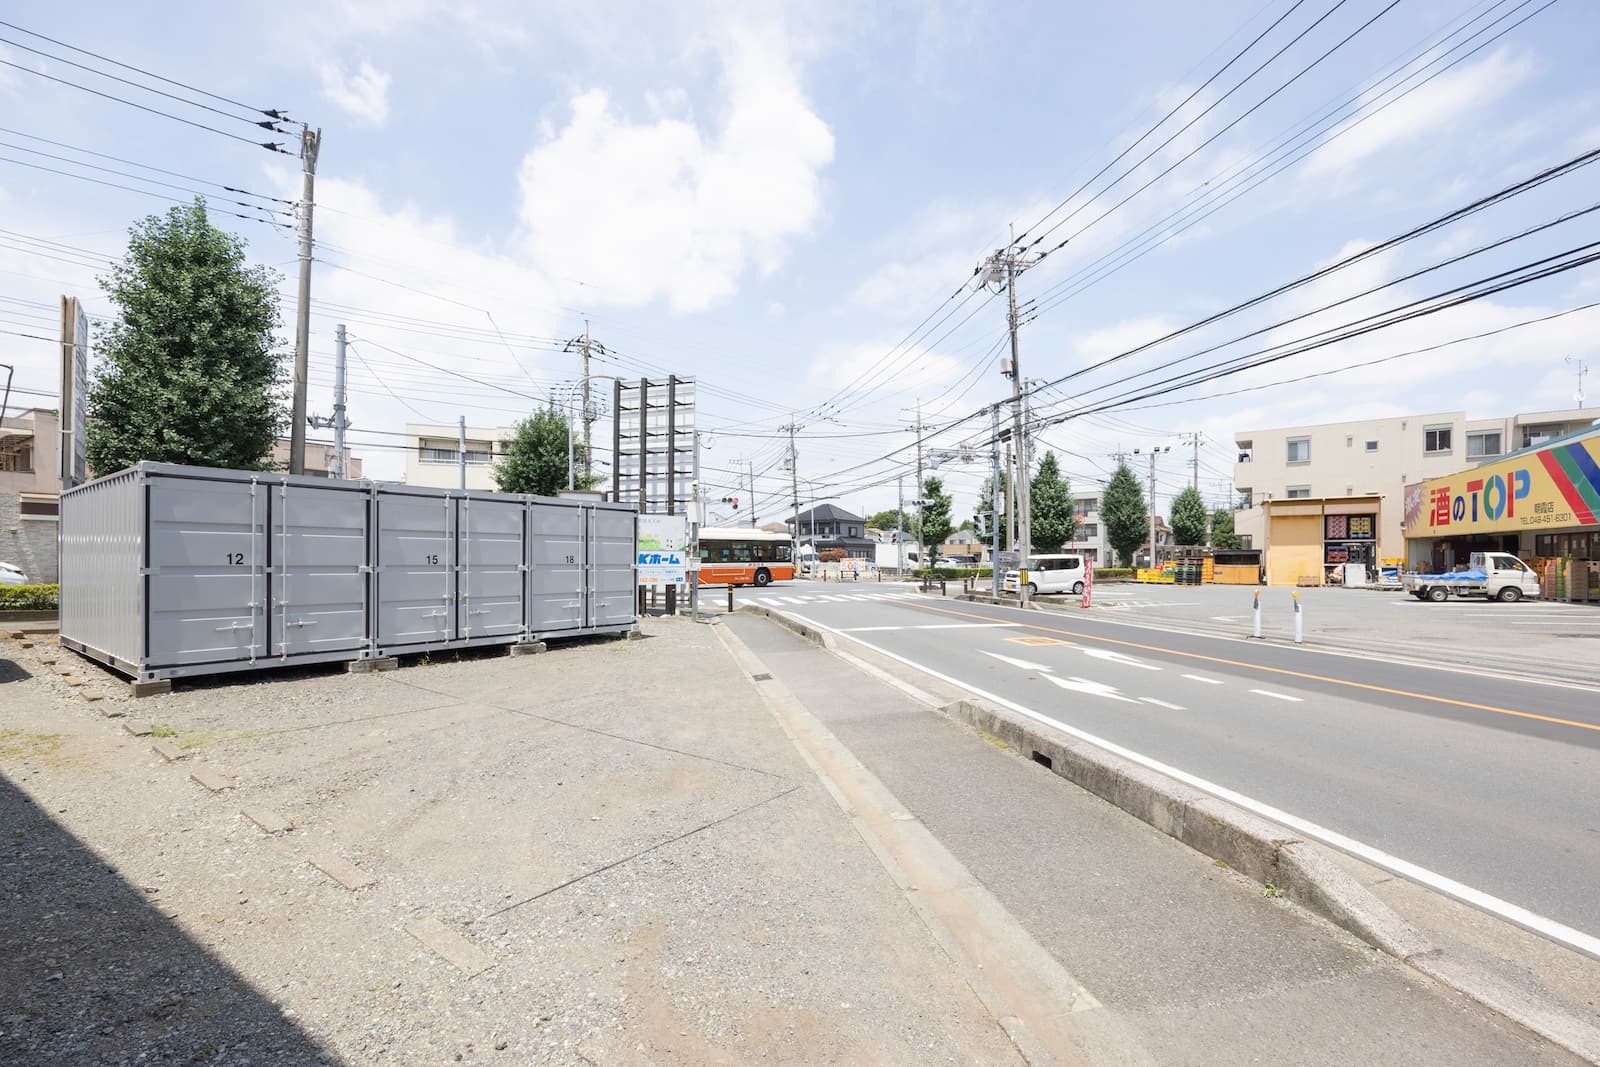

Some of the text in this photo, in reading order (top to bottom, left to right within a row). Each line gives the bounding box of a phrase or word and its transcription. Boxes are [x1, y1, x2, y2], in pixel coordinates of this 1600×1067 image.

[1429, 469, 1531, 527] 酒のTOP
[226, 552, 244, 565] 12
[425, 554, 439, 565] 15
[565, 555, 575, 564] 18
